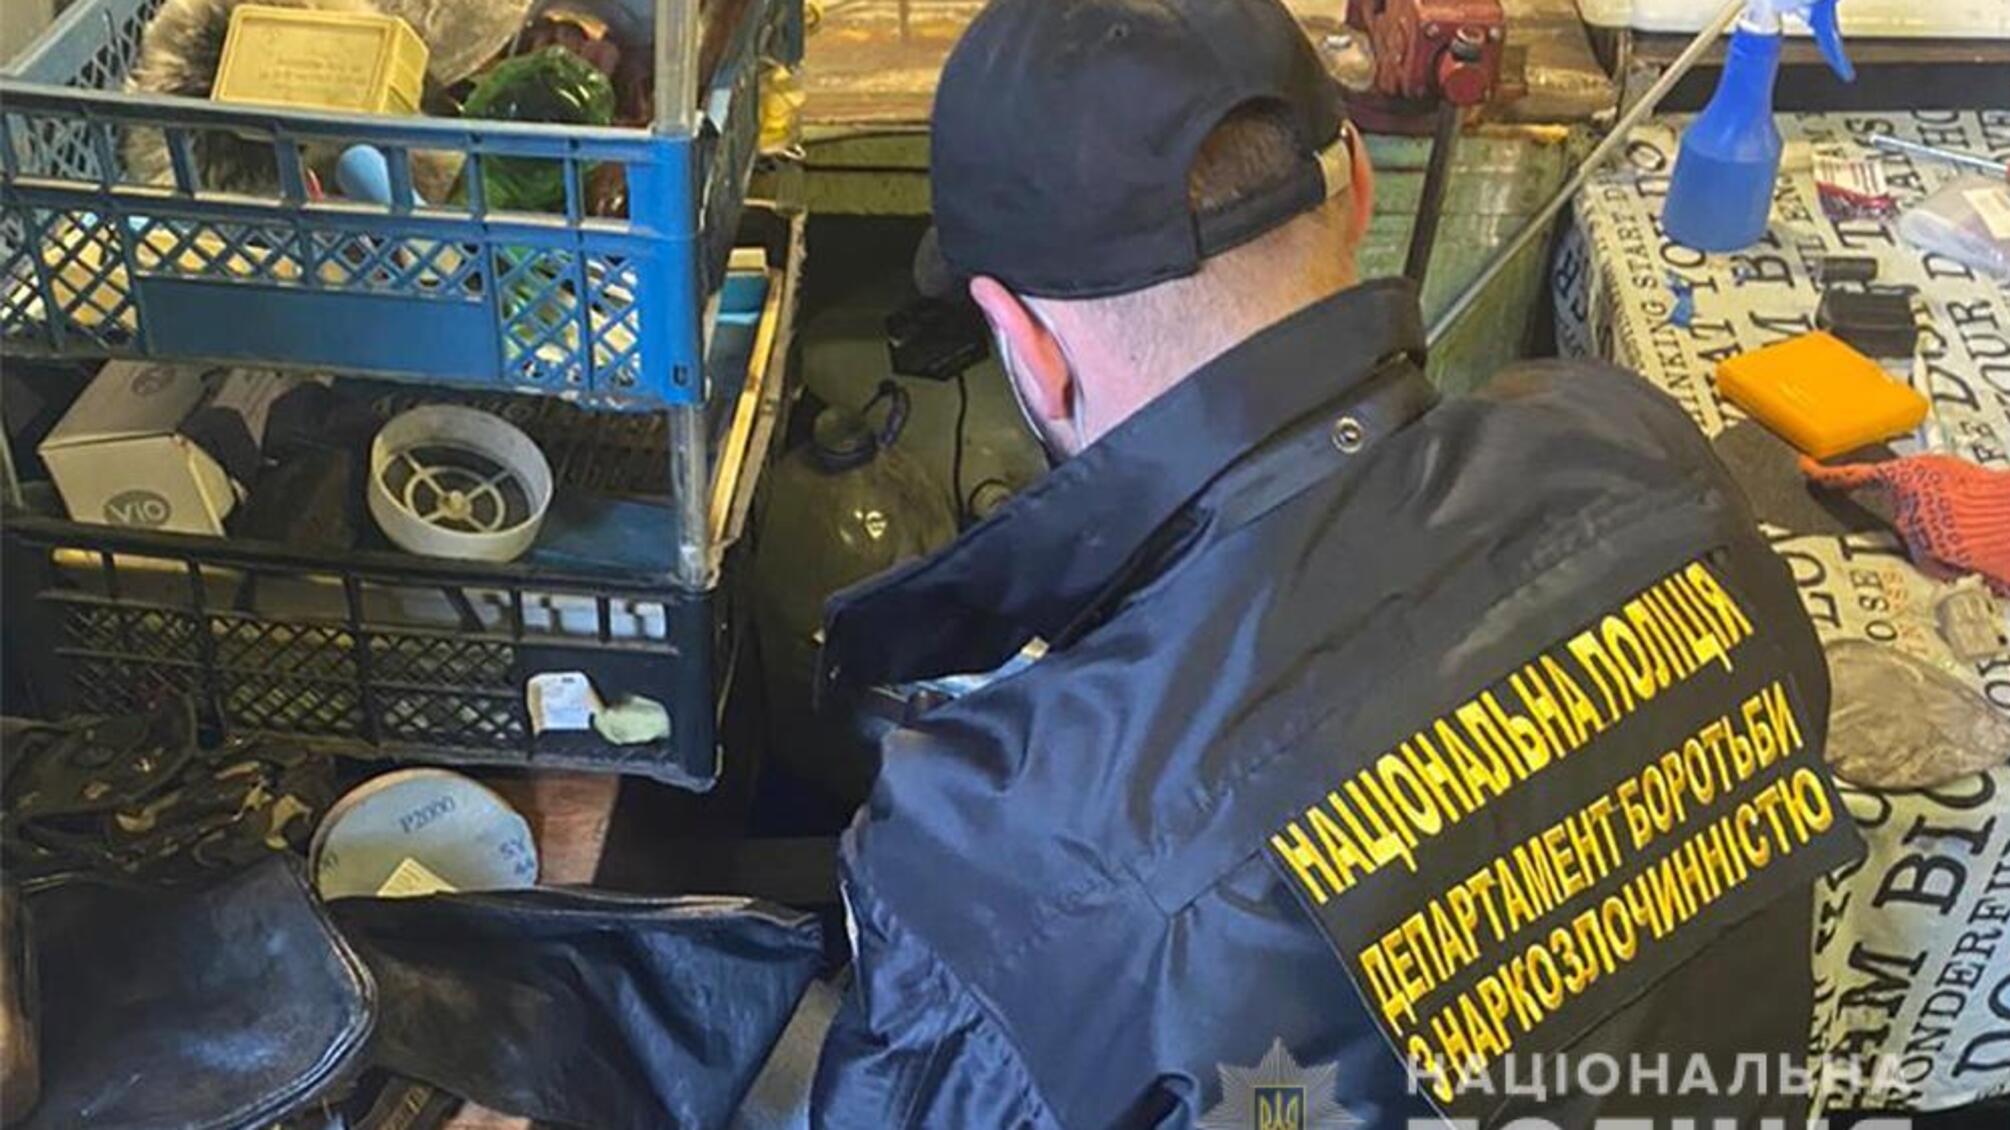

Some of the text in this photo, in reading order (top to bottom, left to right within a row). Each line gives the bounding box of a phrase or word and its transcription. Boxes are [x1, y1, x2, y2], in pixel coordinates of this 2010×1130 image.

[400, 796, 456, 834] P2000
[1271, 655, 1605, 904] НАЦІОНАЛЬНА
[1567, 561, 1754, 722] ПОЛІЦІЯ
[1358, 795, 1622, 1037] ДЕПАРТАМЕНТ
[1616, 681, 1803, 850] БОРОТЬБИ
[1429, 767, 1834, 1088] НАРКОЗЛОЧИННІСТЮ
